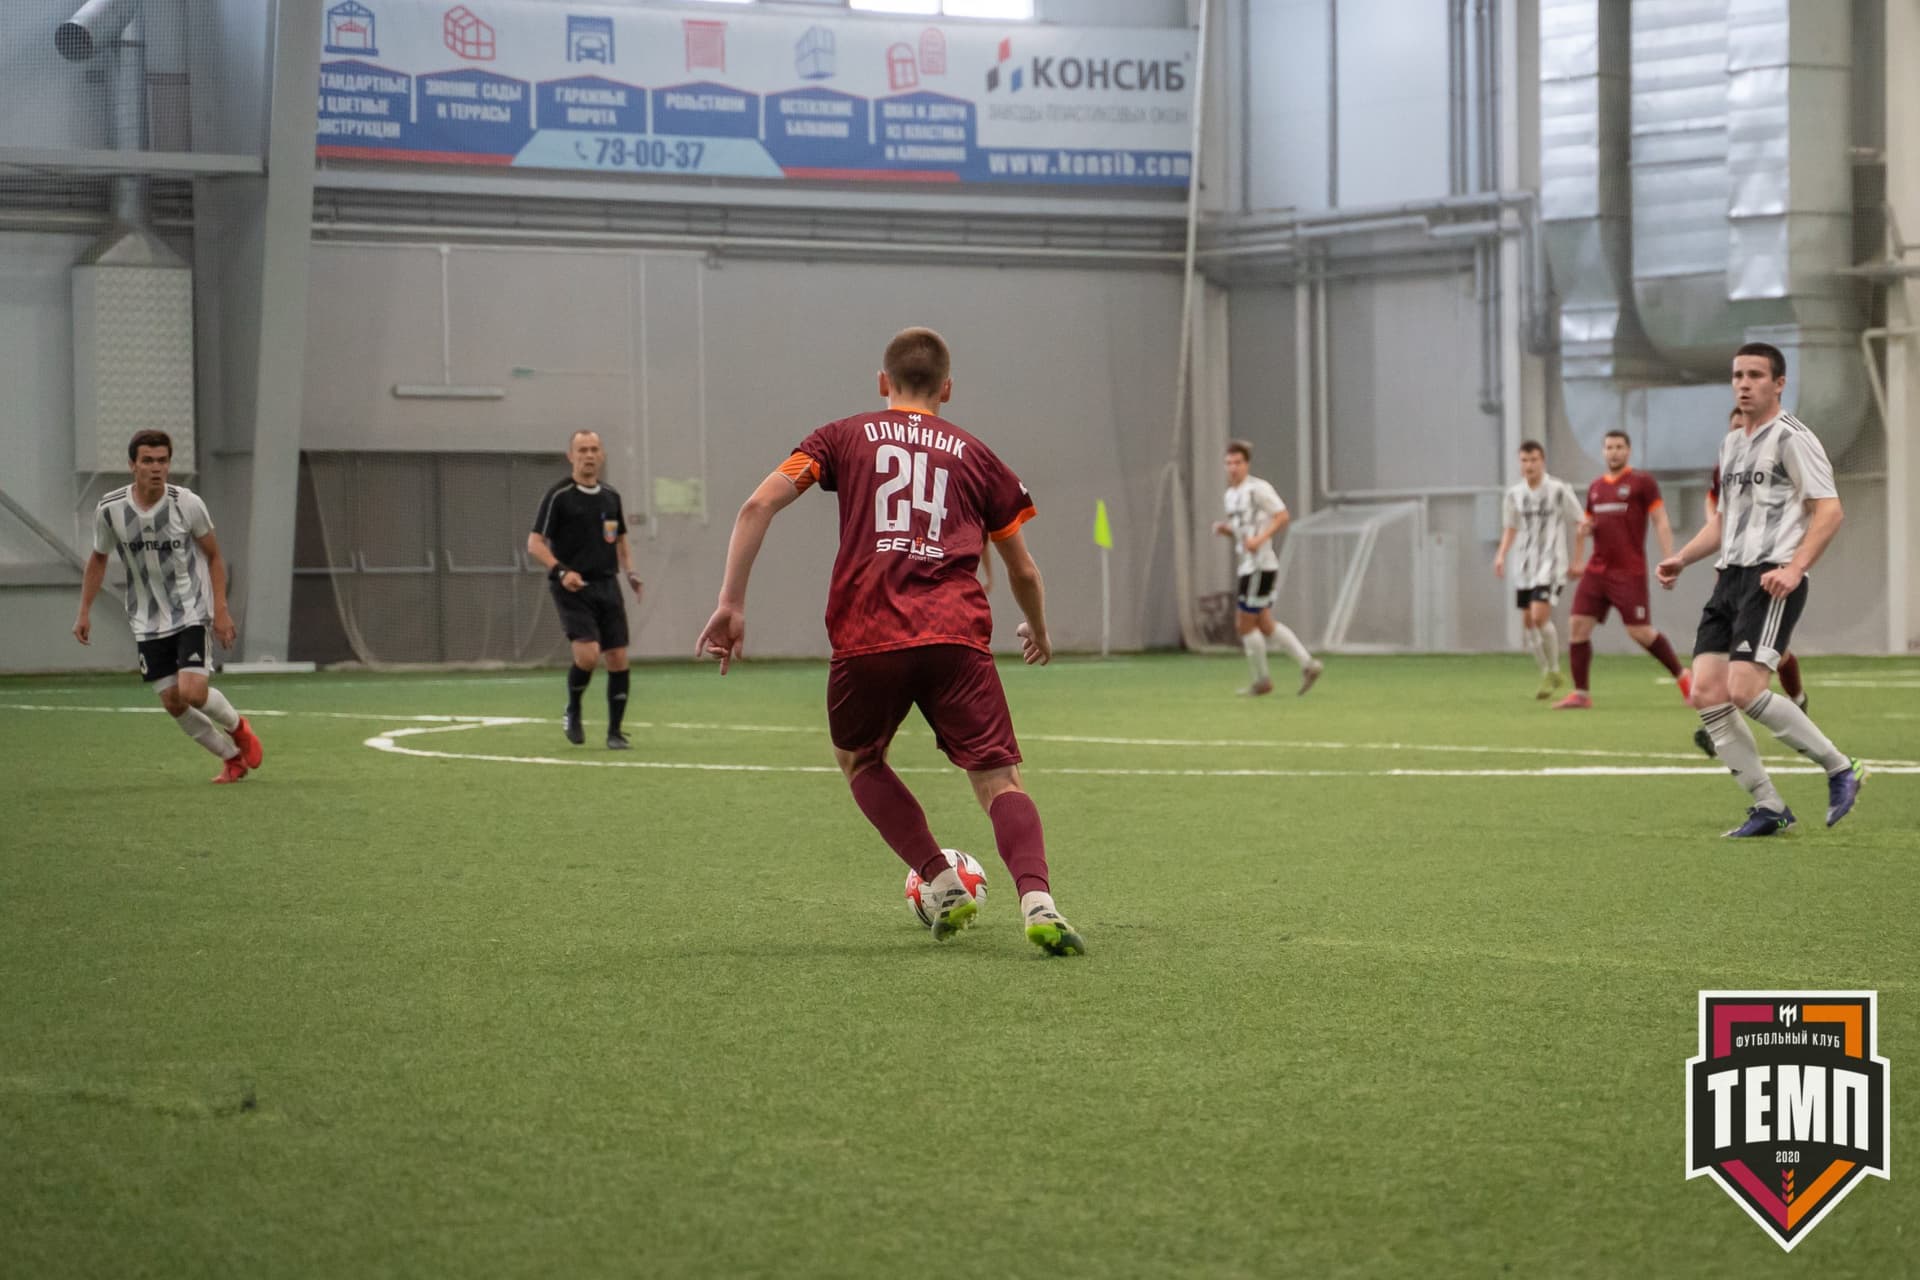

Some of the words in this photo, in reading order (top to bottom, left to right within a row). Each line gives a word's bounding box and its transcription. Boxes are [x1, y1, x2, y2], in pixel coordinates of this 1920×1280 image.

[319, 73, 408, 93] ТАНДАРТНЫЕ
[1033, 56, 1185, 92] КОНСИБ
[595, 138, 706, 169] 73-00-37
[988, 153, 1190, 176] www.konsib.com
[864, 421, 967, 460] ОЛИЙНЫК
[875, 444, 949, 542] 24
